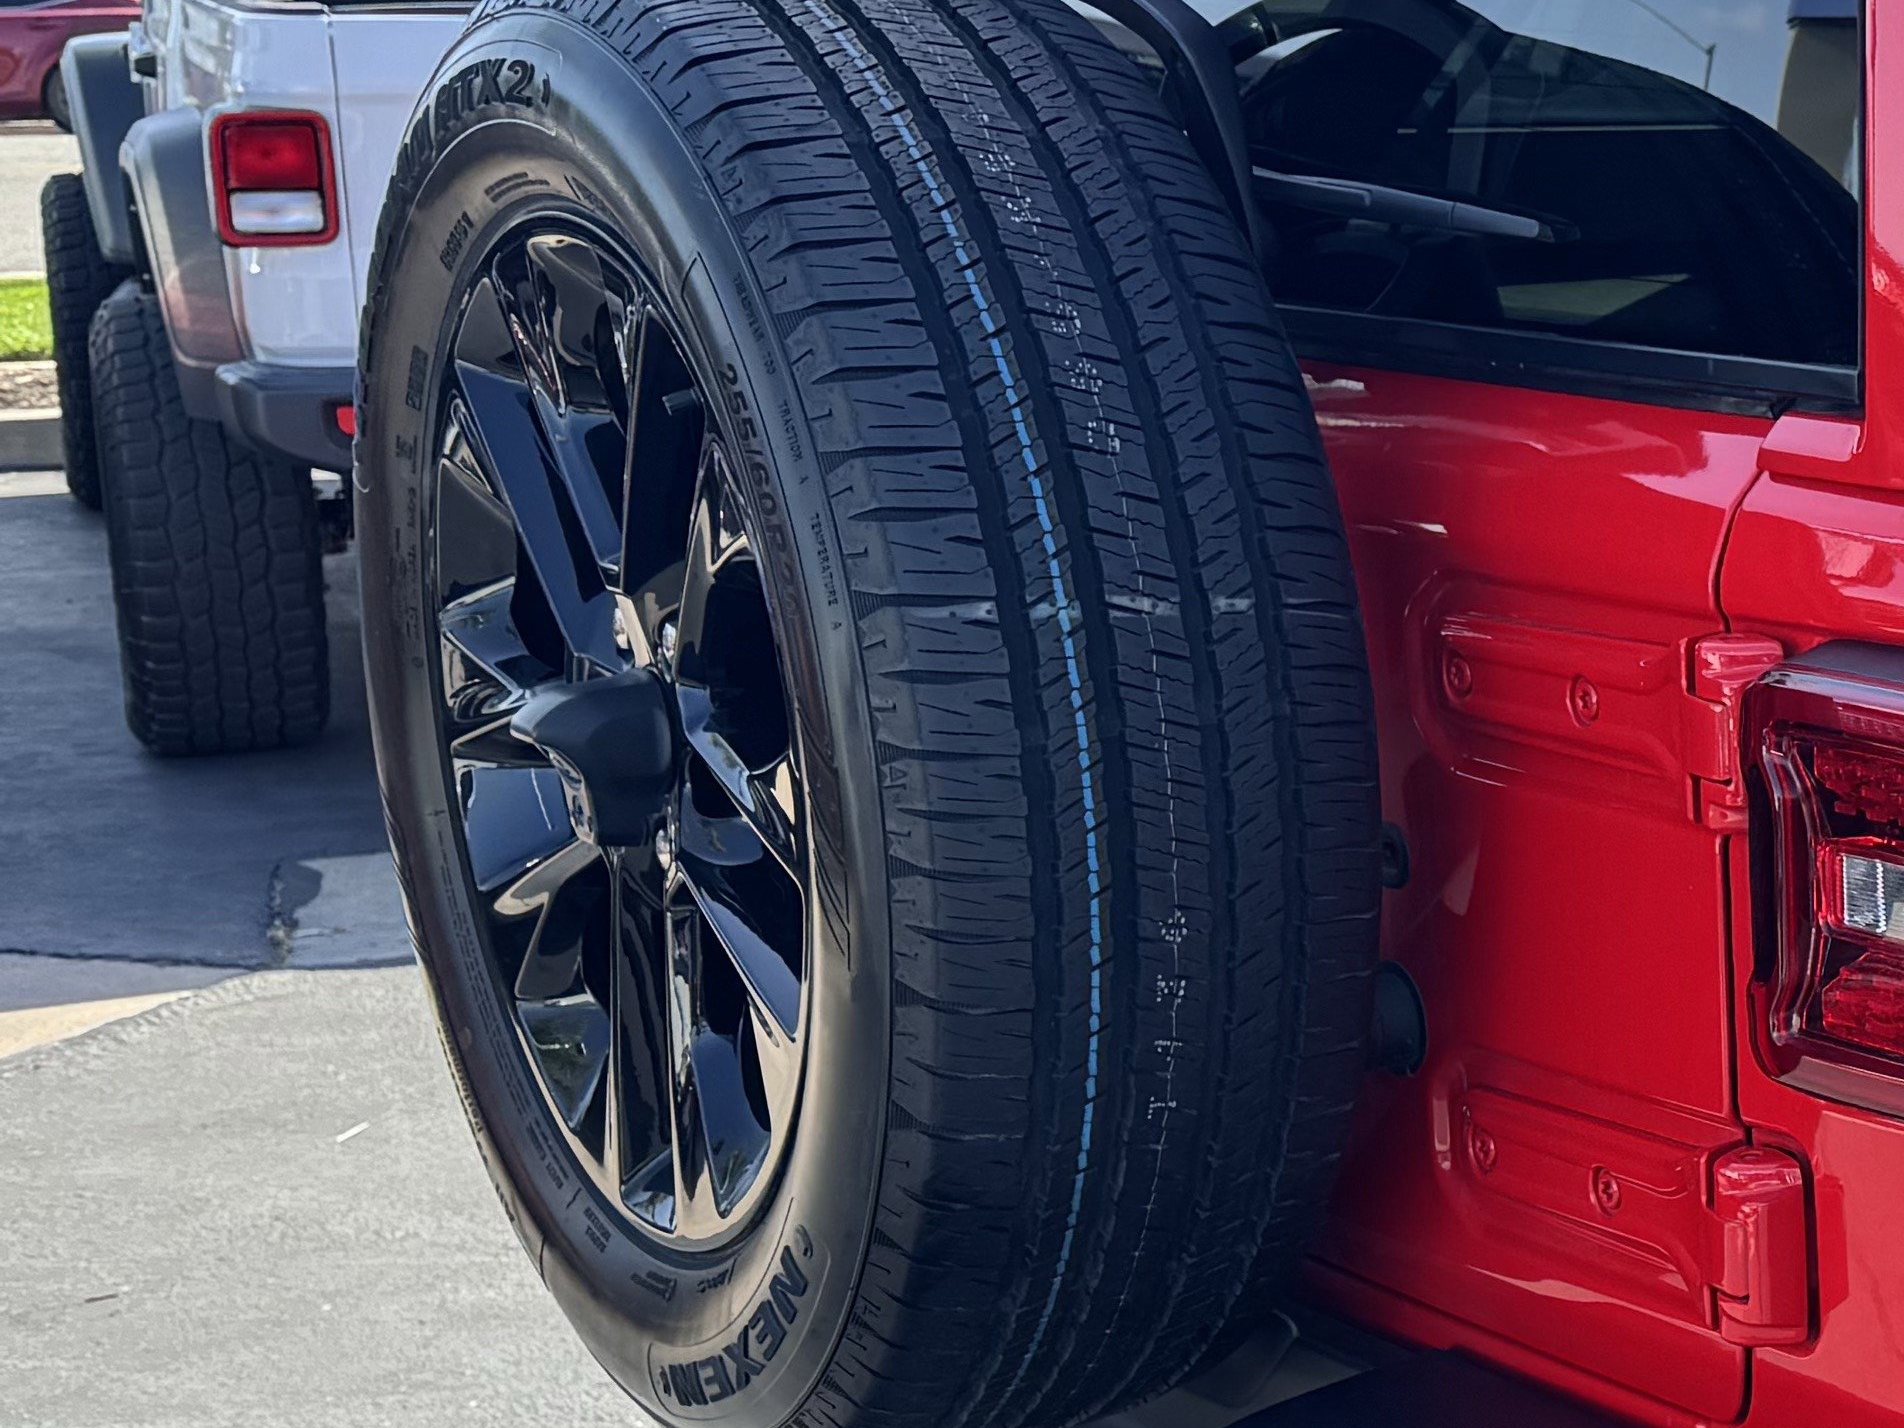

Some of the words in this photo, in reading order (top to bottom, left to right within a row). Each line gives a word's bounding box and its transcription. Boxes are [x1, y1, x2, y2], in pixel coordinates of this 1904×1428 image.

[777, 398, 804, 463] TRACTION
[809, 511, 840, 608] TEMPERATURE
[668, 1244, 809, 1408] NEXEN
